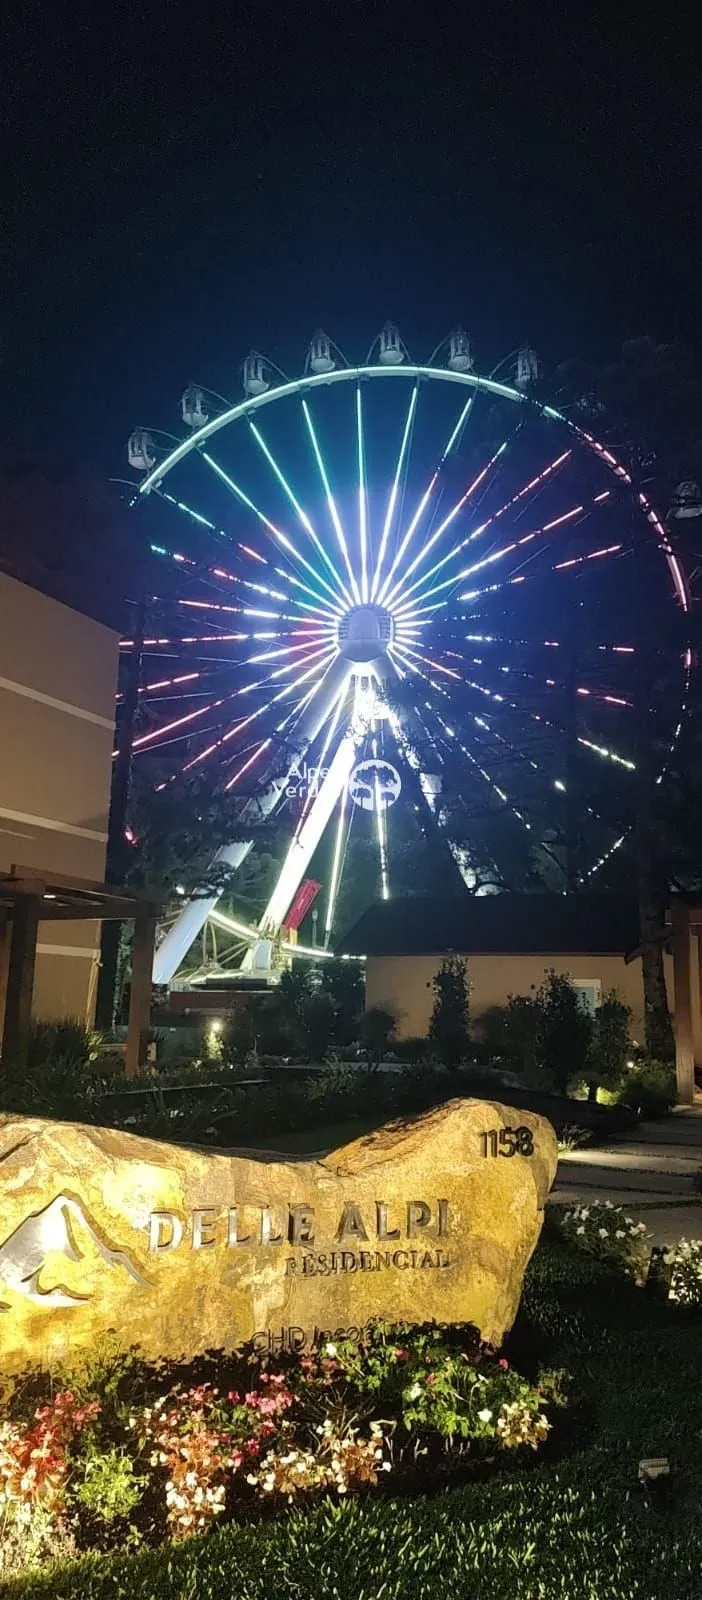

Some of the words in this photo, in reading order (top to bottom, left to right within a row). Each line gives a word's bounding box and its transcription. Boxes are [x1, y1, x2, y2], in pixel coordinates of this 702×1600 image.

[479, 1126, 534, 1158] 1158
[149, 1202, 316, 1253] DELLE
[333, 1199, 450, 1243] ALPI
[284, 1249, 451, 1277] RESIDENCIAL
